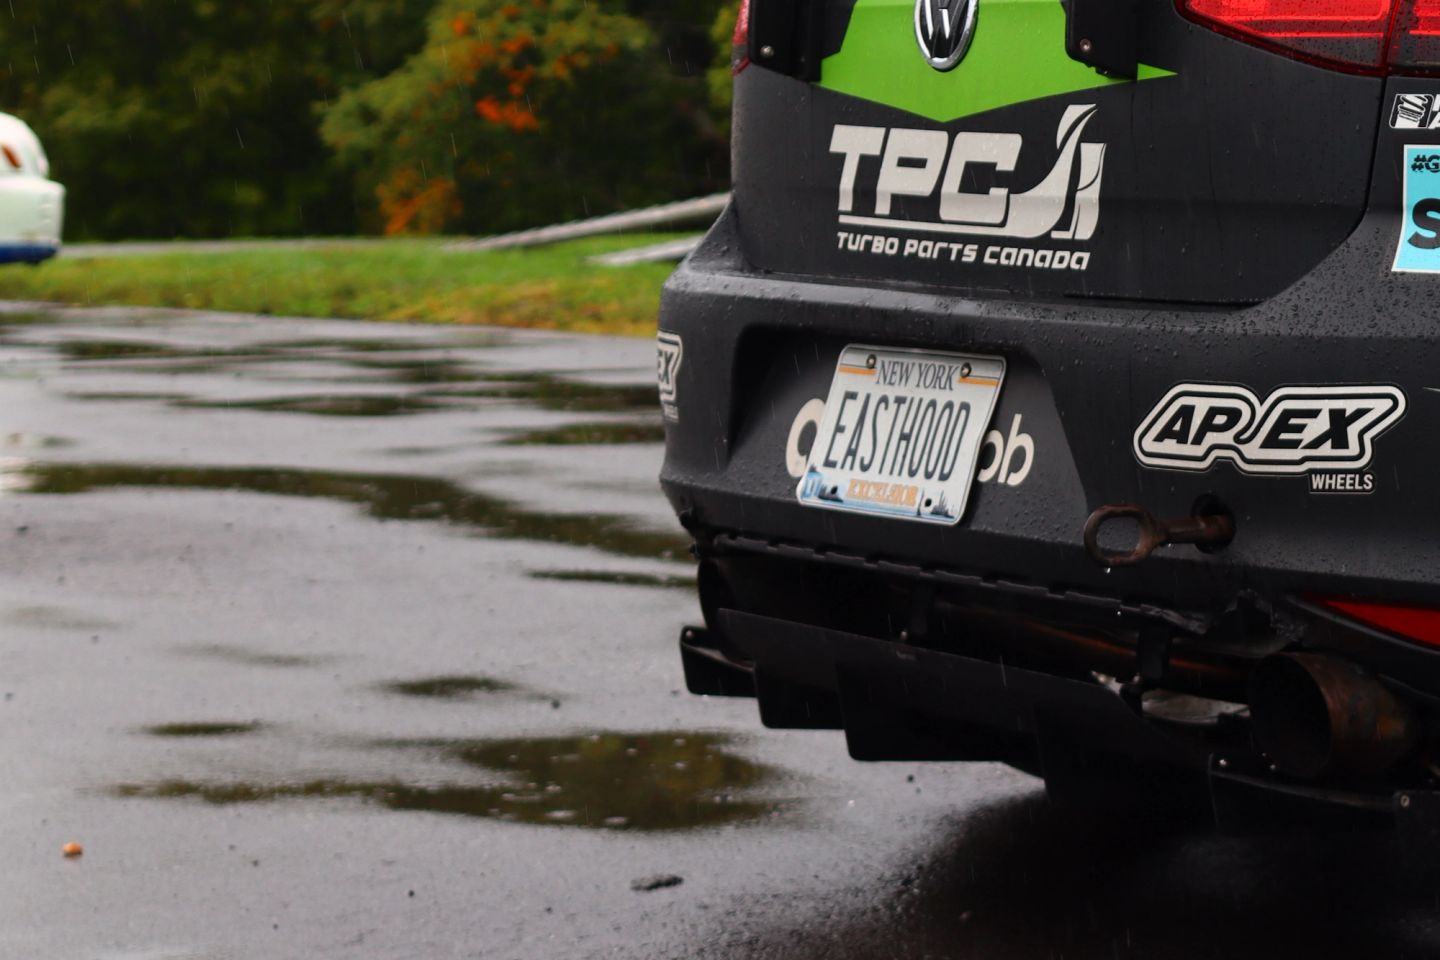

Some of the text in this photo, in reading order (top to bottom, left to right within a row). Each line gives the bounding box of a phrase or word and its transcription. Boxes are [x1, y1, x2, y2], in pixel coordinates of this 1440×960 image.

[829, 124, 1023, 224] TPC
[876, 360, 960, 391] NEW YORK
[823, 390, 971, 482] EASTHOOD
[1149, 402, 1377, 451] APEX
[1311, 473, 1373, 490] WHEELS
